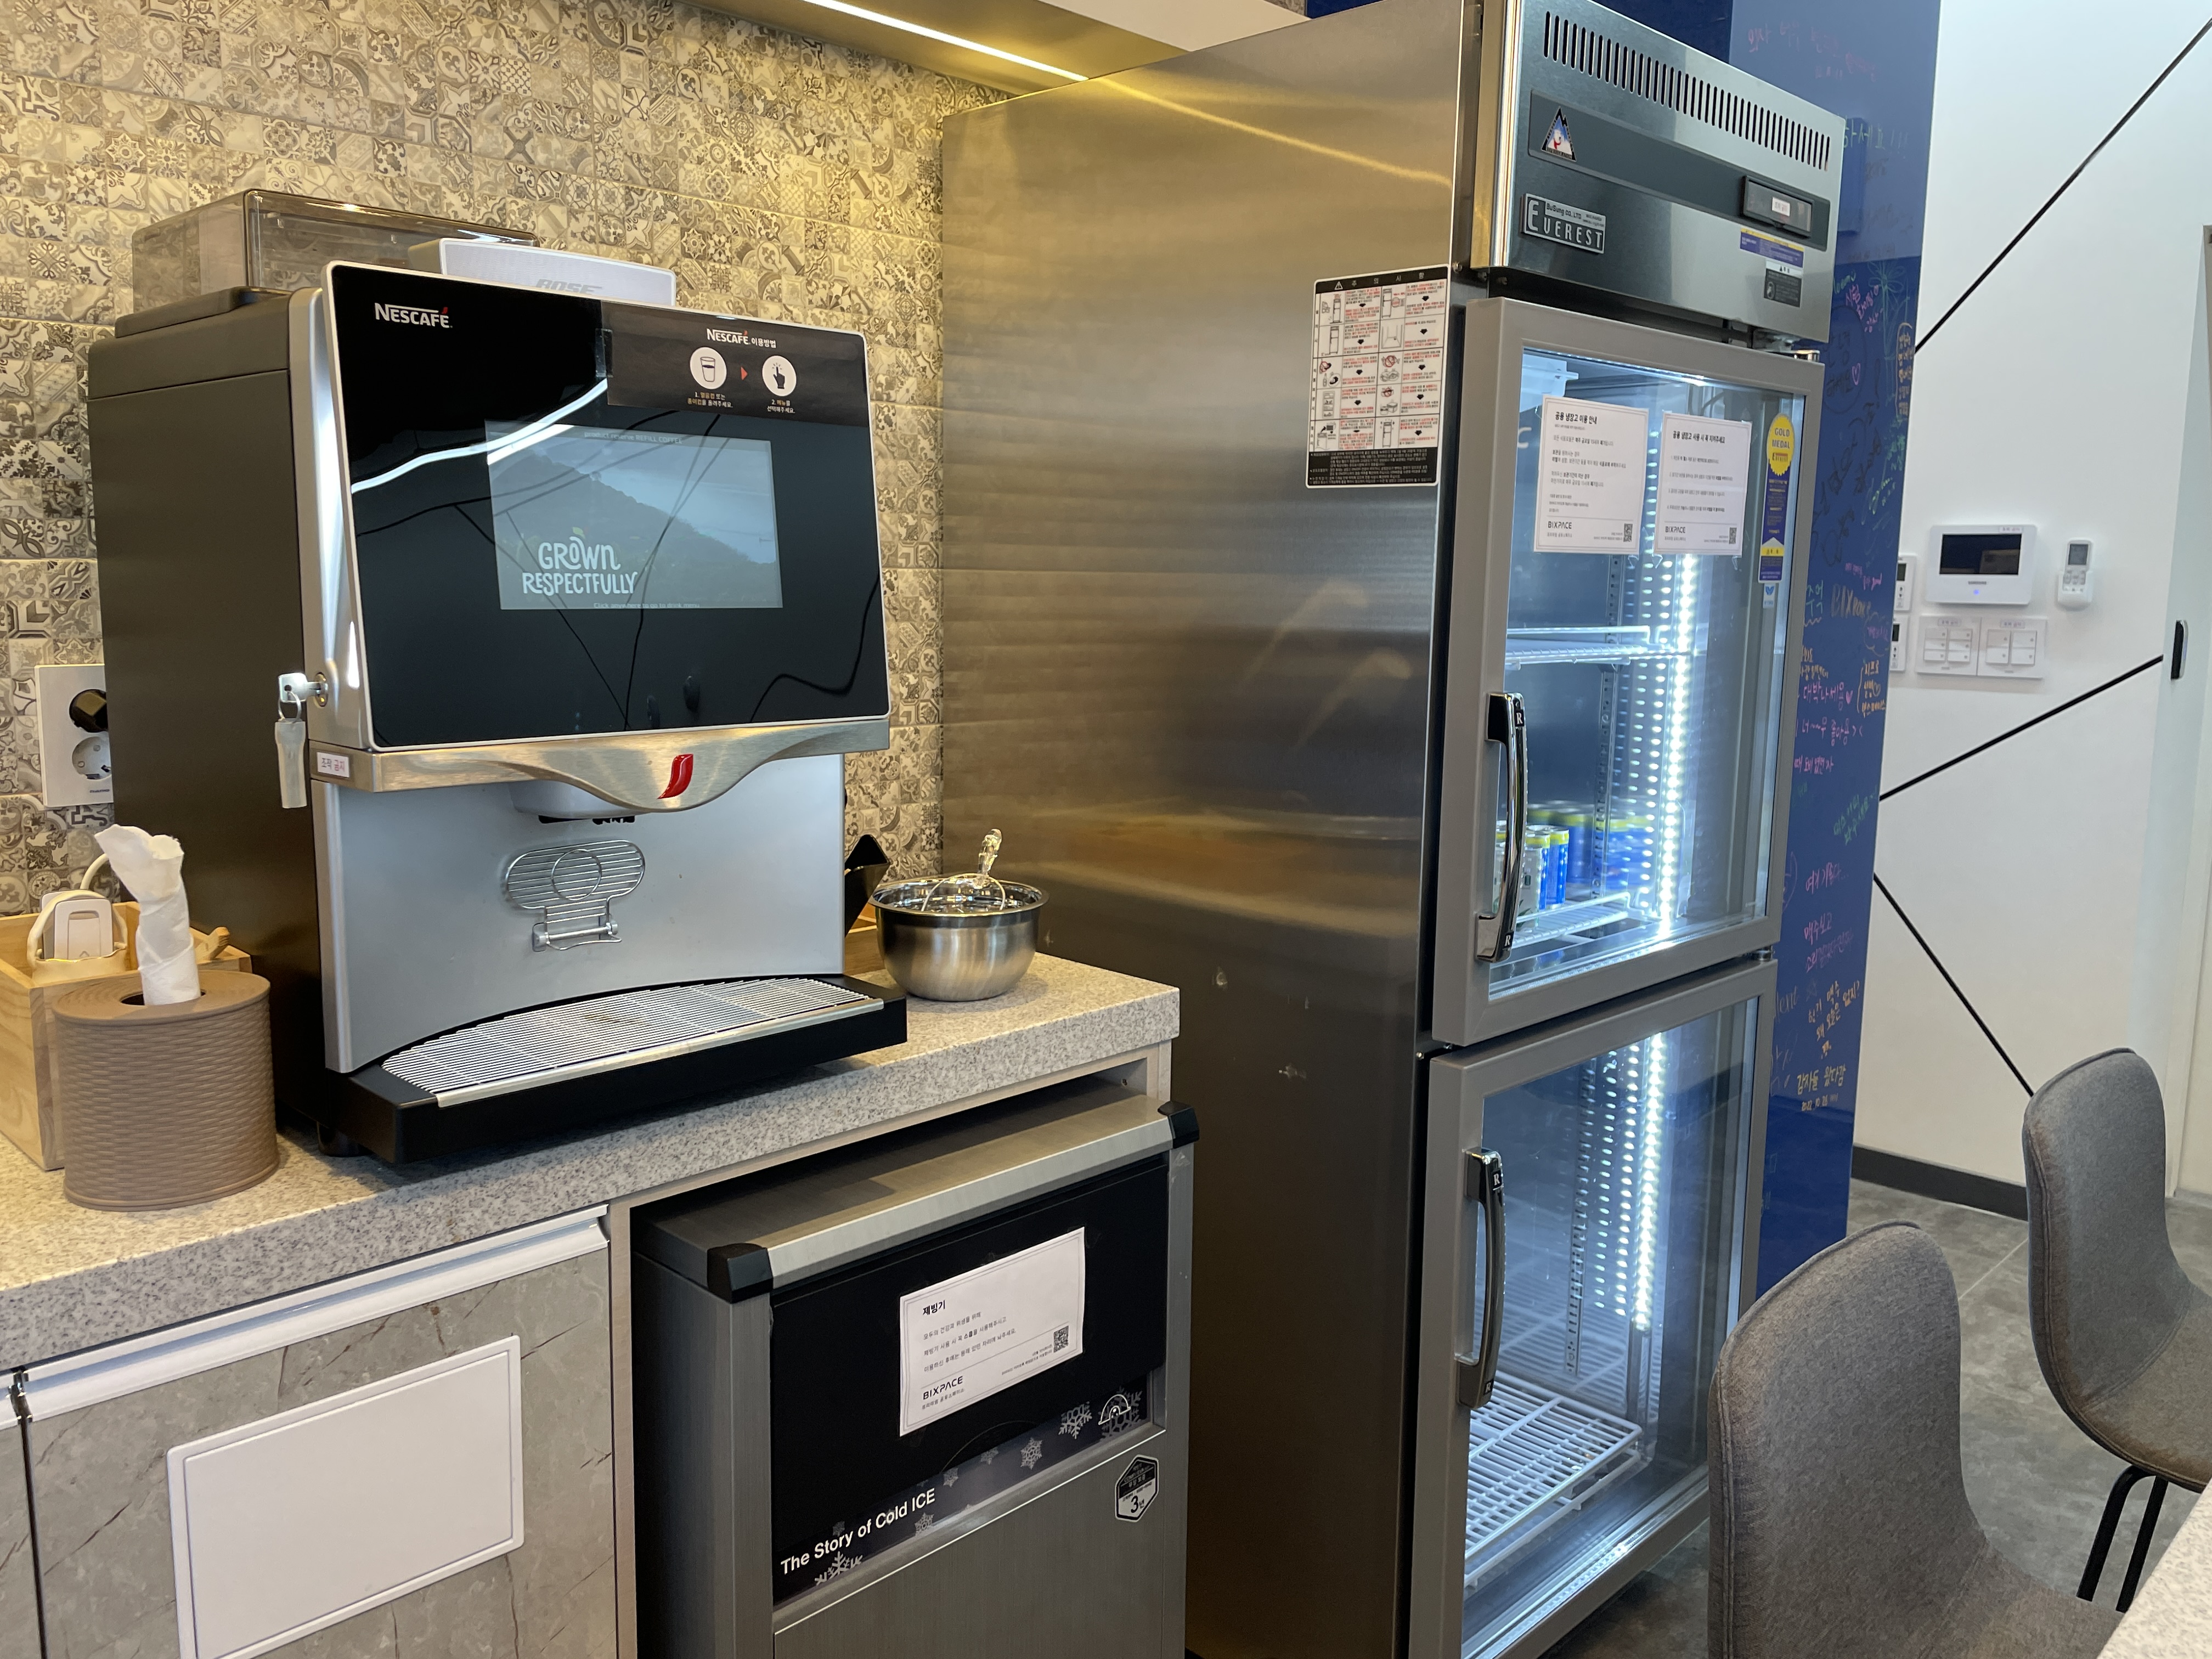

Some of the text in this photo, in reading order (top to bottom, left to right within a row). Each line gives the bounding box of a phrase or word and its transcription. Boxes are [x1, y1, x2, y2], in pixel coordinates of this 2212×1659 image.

[1528, 200, 1602, 248] EVEREST
[752, 337, 776, 348] 이용방법
[1555, 411, 1598, 425] 공용 냉장고 이용 안내
[1775, 427, 1790, 437] GOLD
[1772, 439, 1790, 449] MEDAL
[1548, 521, 1572, 529] BIXPACE
[522, 572, 638, 596] RESPECTFULLY
[321, 758, 345, 772] 조작 금지
[922, 1300, 946, 1316] 제빙기
[940, 1323, 955, 1334] 건강과
[924, 1345, 939, 1356] 제빙기
[940, 1340, 950, 1350] 사용
[923, 1375, 963, 1400] BIXPACE
[781, 1487, 935, 1575] The Story of Cold ICE
